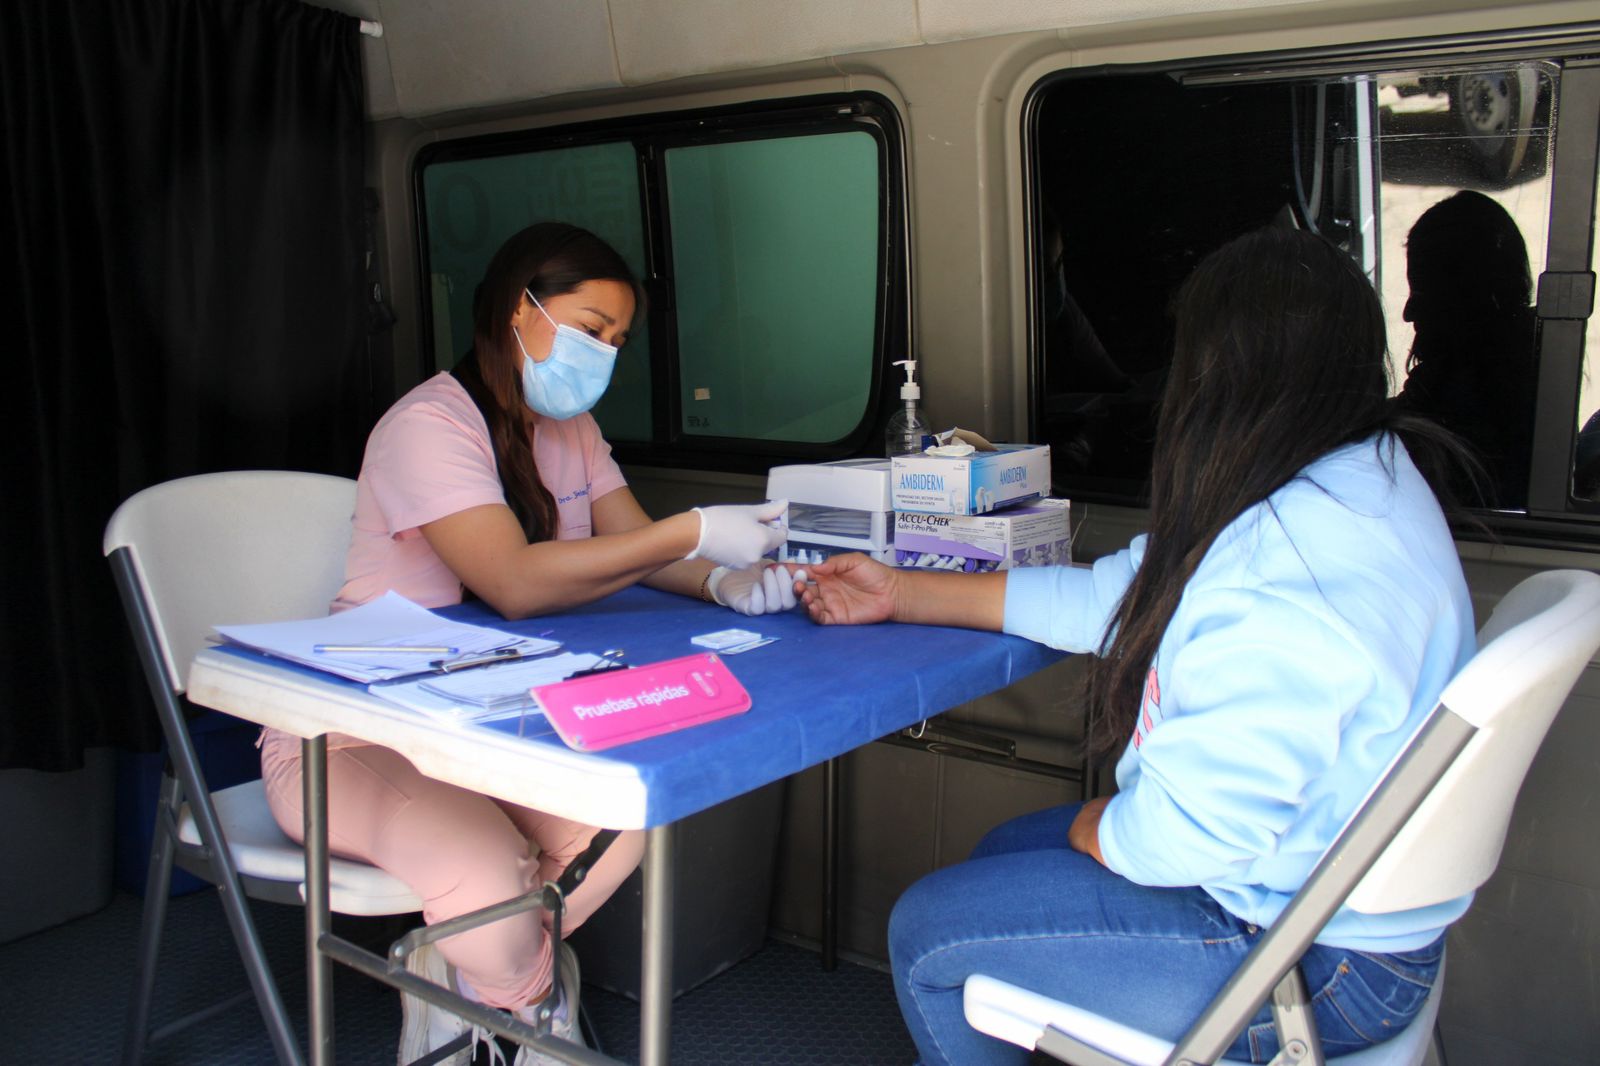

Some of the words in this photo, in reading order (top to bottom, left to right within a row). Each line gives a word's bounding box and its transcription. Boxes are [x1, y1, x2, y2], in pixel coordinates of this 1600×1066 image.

[900, 472, 944, 492] AMBIDERM
[898, 512, 951, 527] ACCU-CHEK
[573, 697, 638, 720] Pruebas
[636, 685, 689, 706] rápidas
